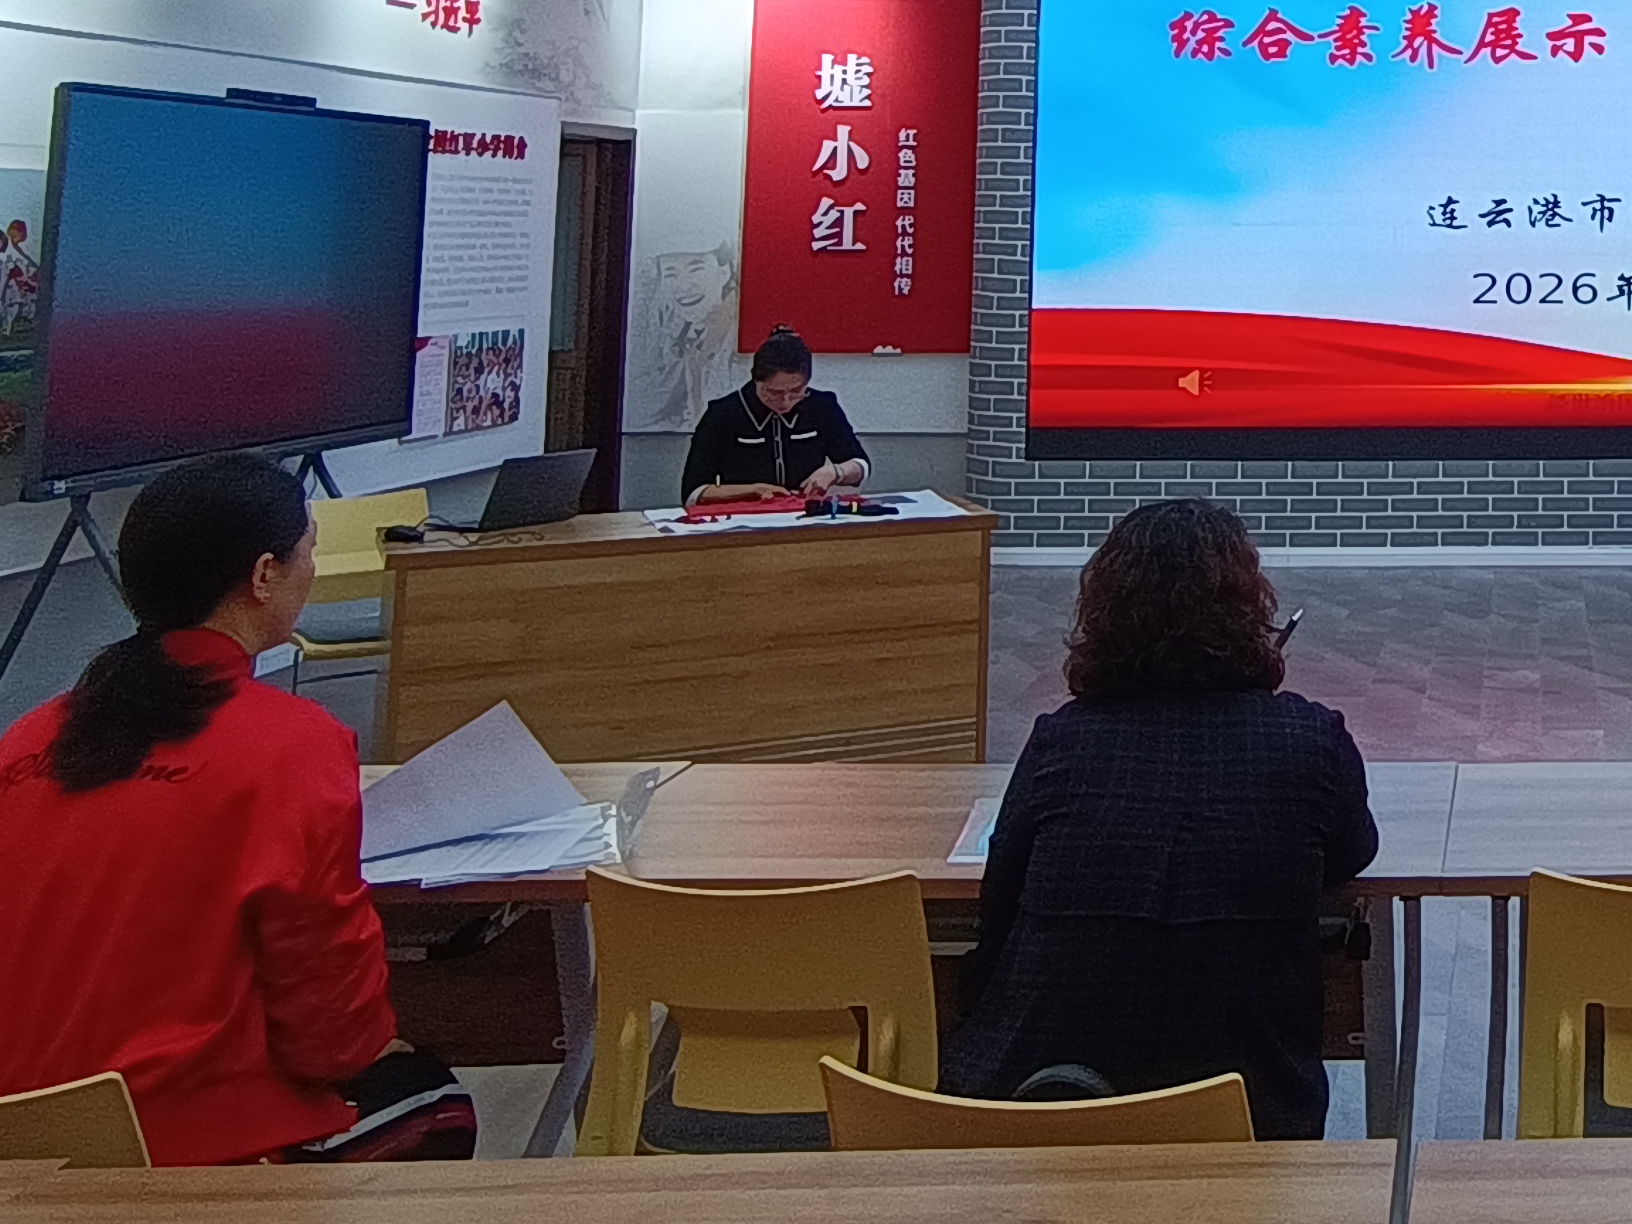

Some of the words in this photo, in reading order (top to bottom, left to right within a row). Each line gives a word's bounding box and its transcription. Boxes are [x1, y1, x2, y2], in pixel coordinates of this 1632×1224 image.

[811, 53, 874, 251] 墟小红
[894, 216, 915, 296] 代代相传
